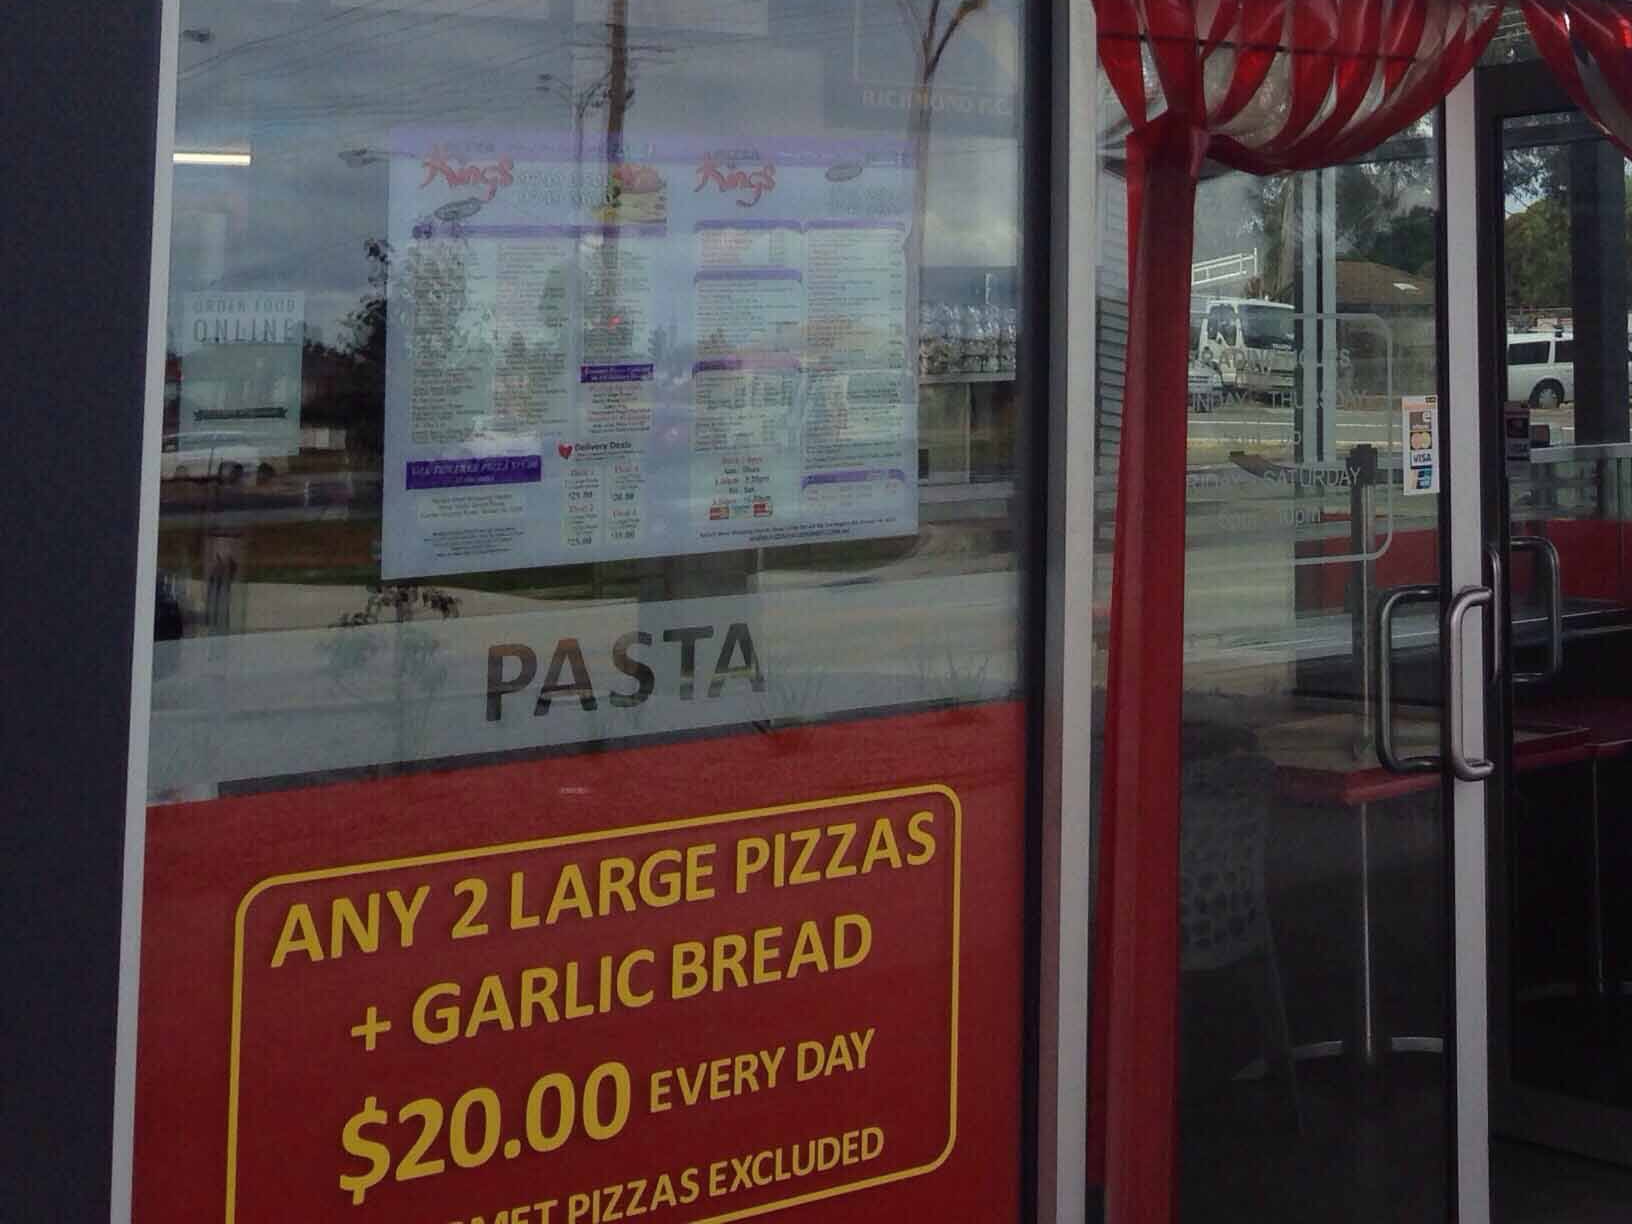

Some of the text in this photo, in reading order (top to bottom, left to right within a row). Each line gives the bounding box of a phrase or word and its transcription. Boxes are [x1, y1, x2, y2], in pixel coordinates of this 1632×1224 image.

[1262, 465, 1362, 489] SATURDAY
[1412, 452, 1433, 465] VISA
[485, 622, 768, 722] PASTA
[270, 811, 938, 968] ANY 2 LARGE PIZZAS
[412, 948, 656, 1045] GARLIC
[672, 913, 874, 1001] BREAD
[339, 1028, 877, 1206] $20.00 EVERY DAY
[568, 1167, 701, 1224] PIZZAS
[709, 1126, 885, 1197] EXCLUDED
